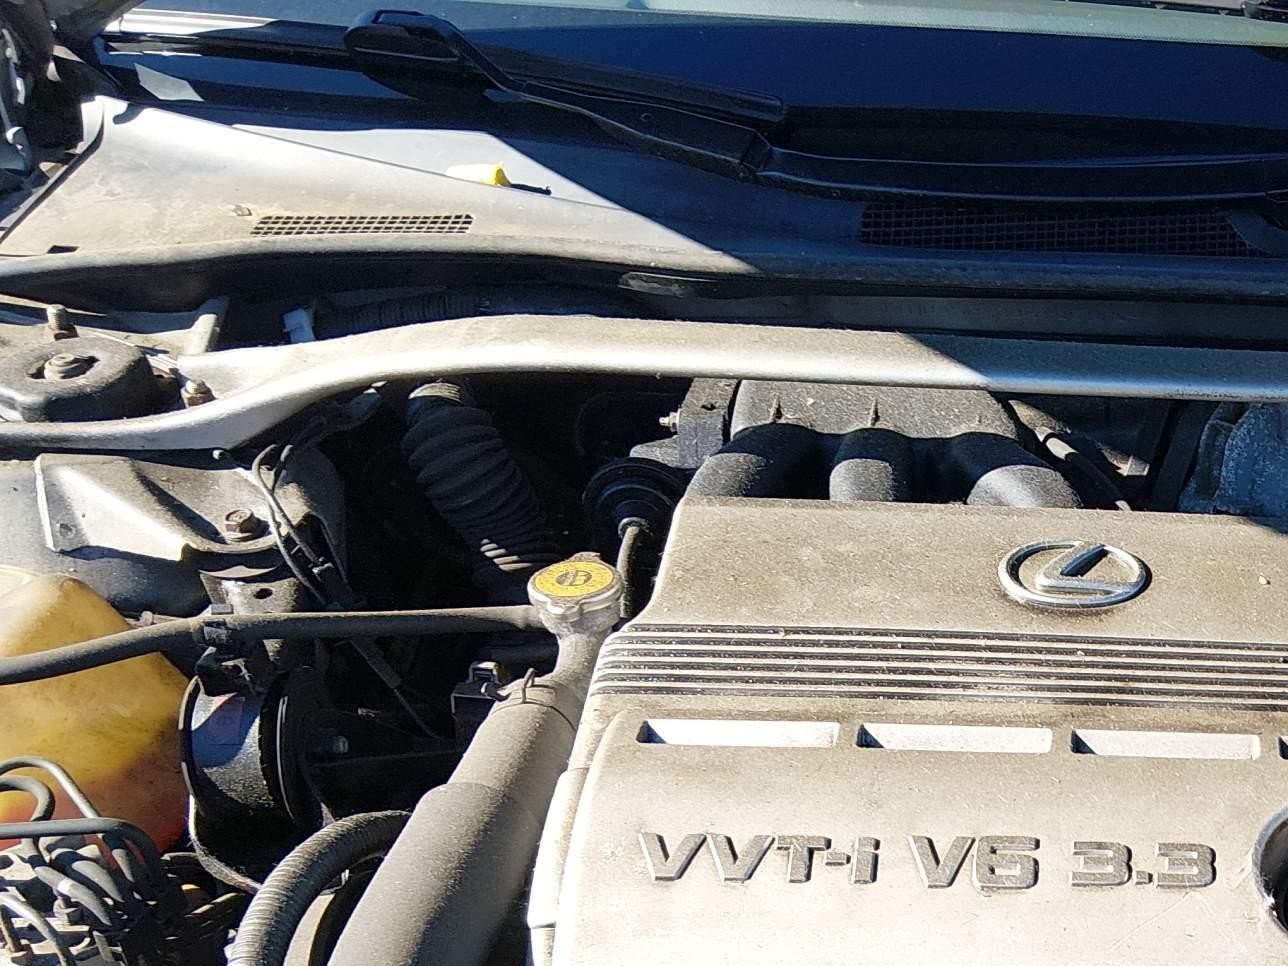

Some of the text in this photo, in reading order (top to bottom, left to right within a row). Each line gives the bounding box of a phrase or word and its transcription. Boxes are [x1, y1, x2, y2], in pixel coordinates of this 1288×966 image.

[638, 832, 1217, 890] VVT-i V6 3.3
